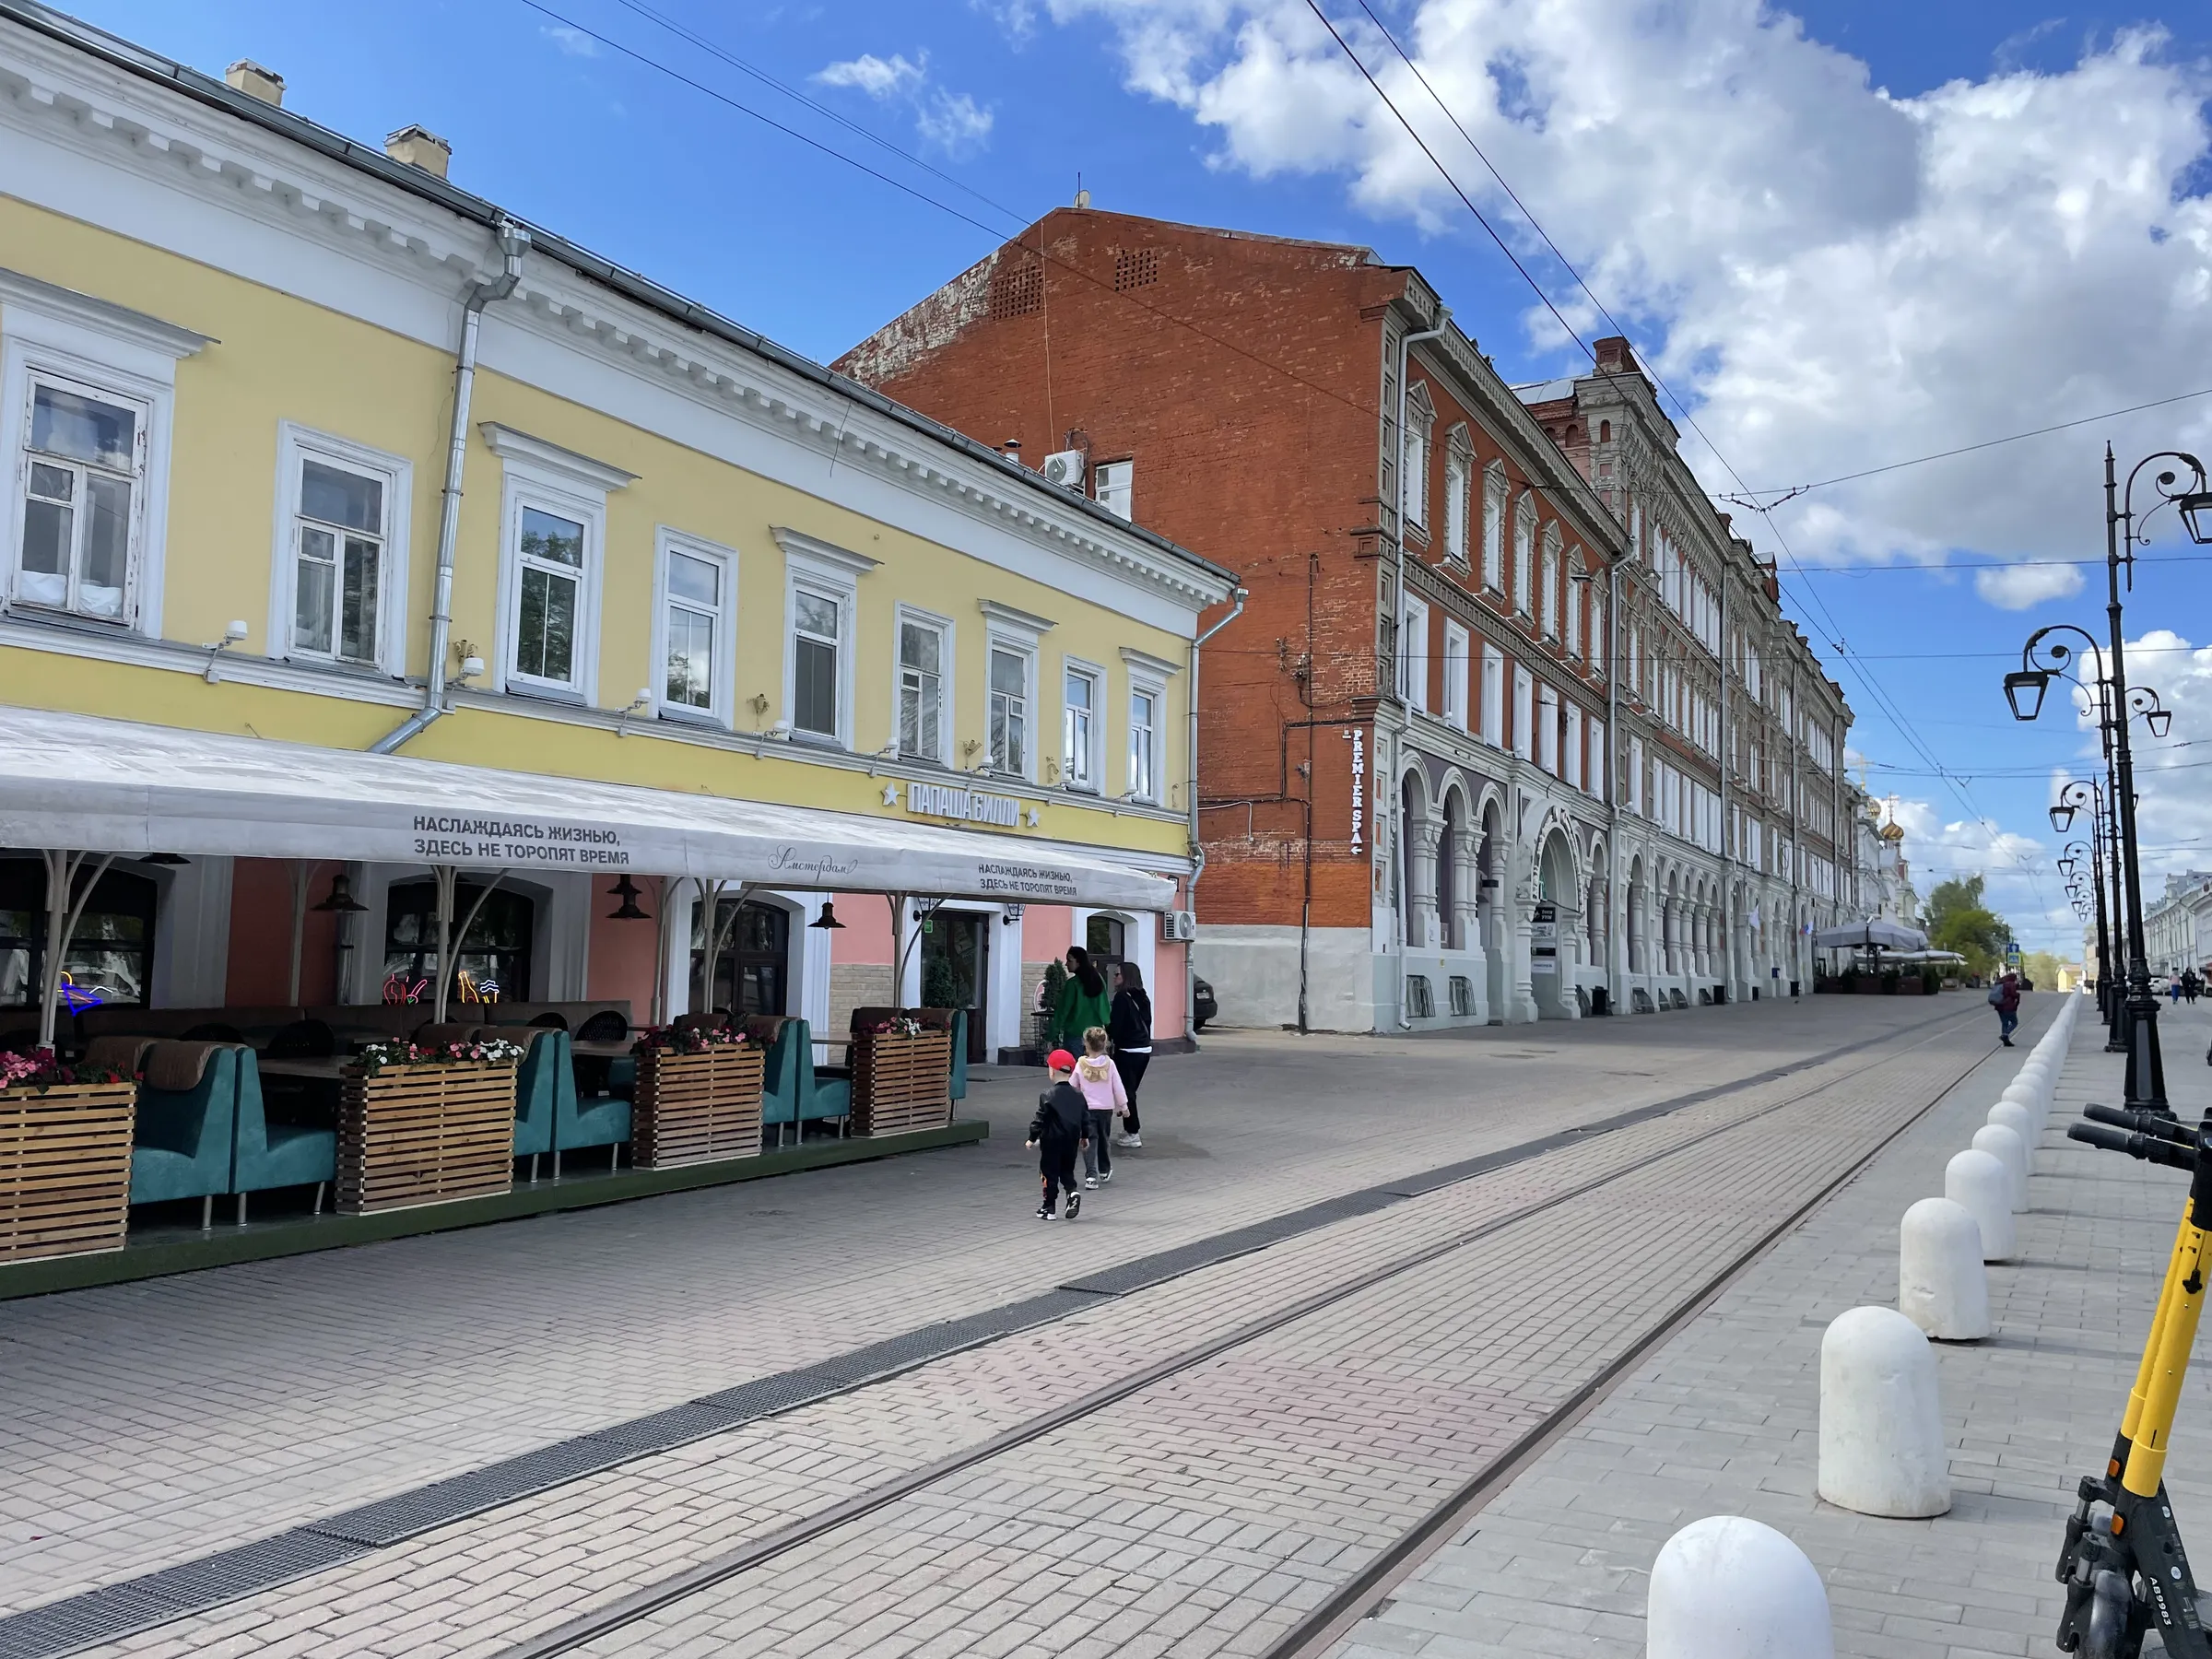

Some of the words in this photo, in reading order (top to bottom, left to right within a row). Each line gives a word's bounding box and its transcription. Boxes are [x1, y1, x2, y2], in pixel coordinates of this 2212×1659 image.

[1352, 730, 1364, 807] PREMIER
[908, 783, 971, 819] ПАПАША
[974, 794, 1020, 827] БИЛЛИ
[414, 816, 544, 839] НАСЛАЖДАЯСЬ
[547, 826, 620, 846] ЖИЗНЬЮ,
[1351, 810, 1362, 843] SPA
[414, 839, 473, 857] ЗДЕСЬ
[478, 842, 501, 857] НЕ
[504, 844, 575, 862] ТОРОПЯТ
[580, 849, 629, 865] ВРЕМЯ
[768, 844, 858, 881] Амстердам
[979, 864, 1037, 878] НАСЛАЖДАЯСЬ
[1039, 870, 1073, 883] ЖИЗНЬЮ,
[980, 878, 1008, 889] ЗДЕСЬ
[1009, 880, 1019, 890] НЕ
[1020, 882, 1053, 893] ТОРОПЯТ
[1054, 886, 1077, 896] ВРЕМЯ
